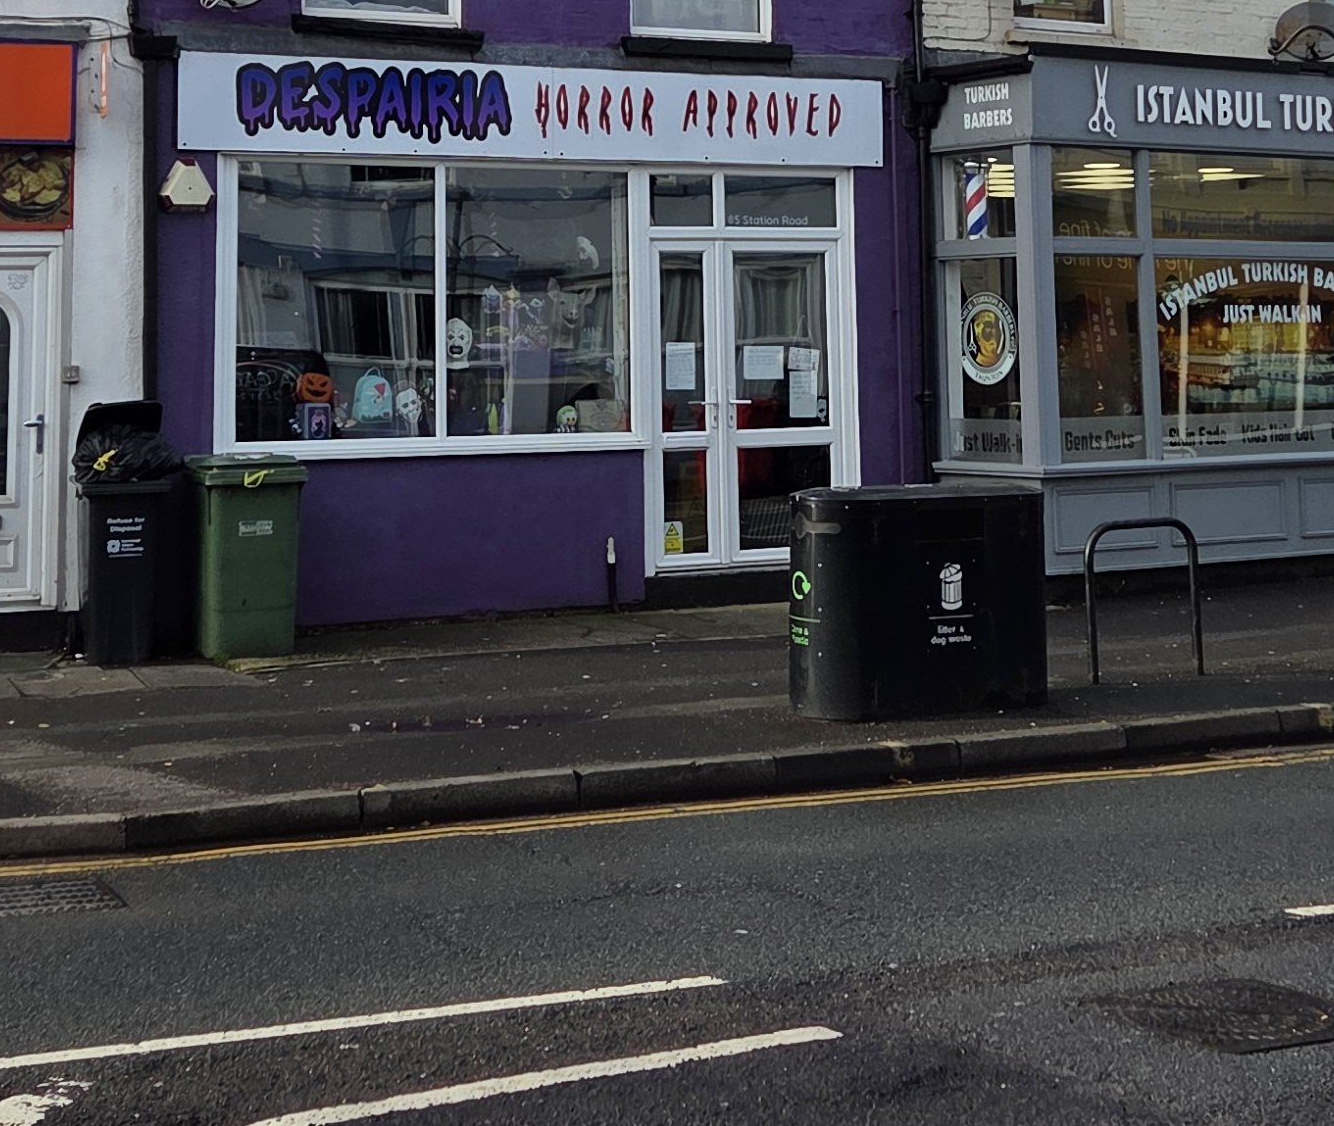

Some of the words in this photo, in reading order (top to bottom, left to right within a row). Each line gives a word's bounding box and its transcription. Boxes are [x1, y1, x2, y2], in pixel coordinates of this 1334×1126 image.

[236, 61, 513, 145] DESPAIRIA
[535, 80, 654, 140] HORROR
[682, 89, 843, 140] APPROVED
[964, 82, 1009, 105] TURKISH
[1137, 84, 1272, 129] ISTANBUL
[964, 108, 1013, 130] BARBERS
[742, 215, 779, 225] Station
[781, 215, 809, 225] Road
[1159, 267, 1238, 321] ISTANBUL
[1241, 261, 1308, 284] TURKISH
[1222, 304, 1255, 324] JUST
[954, 431, 983, 452] Just
[982, 431, 1022, 453] Walk-i
[1066, 431, 1103, 452] Gents
[1105, 429, 1135, 450] Cuts
[930, 635, 947, 646] dog
[948, 634, 972, 643] waste
[937, 625, 956, 634] Litter
